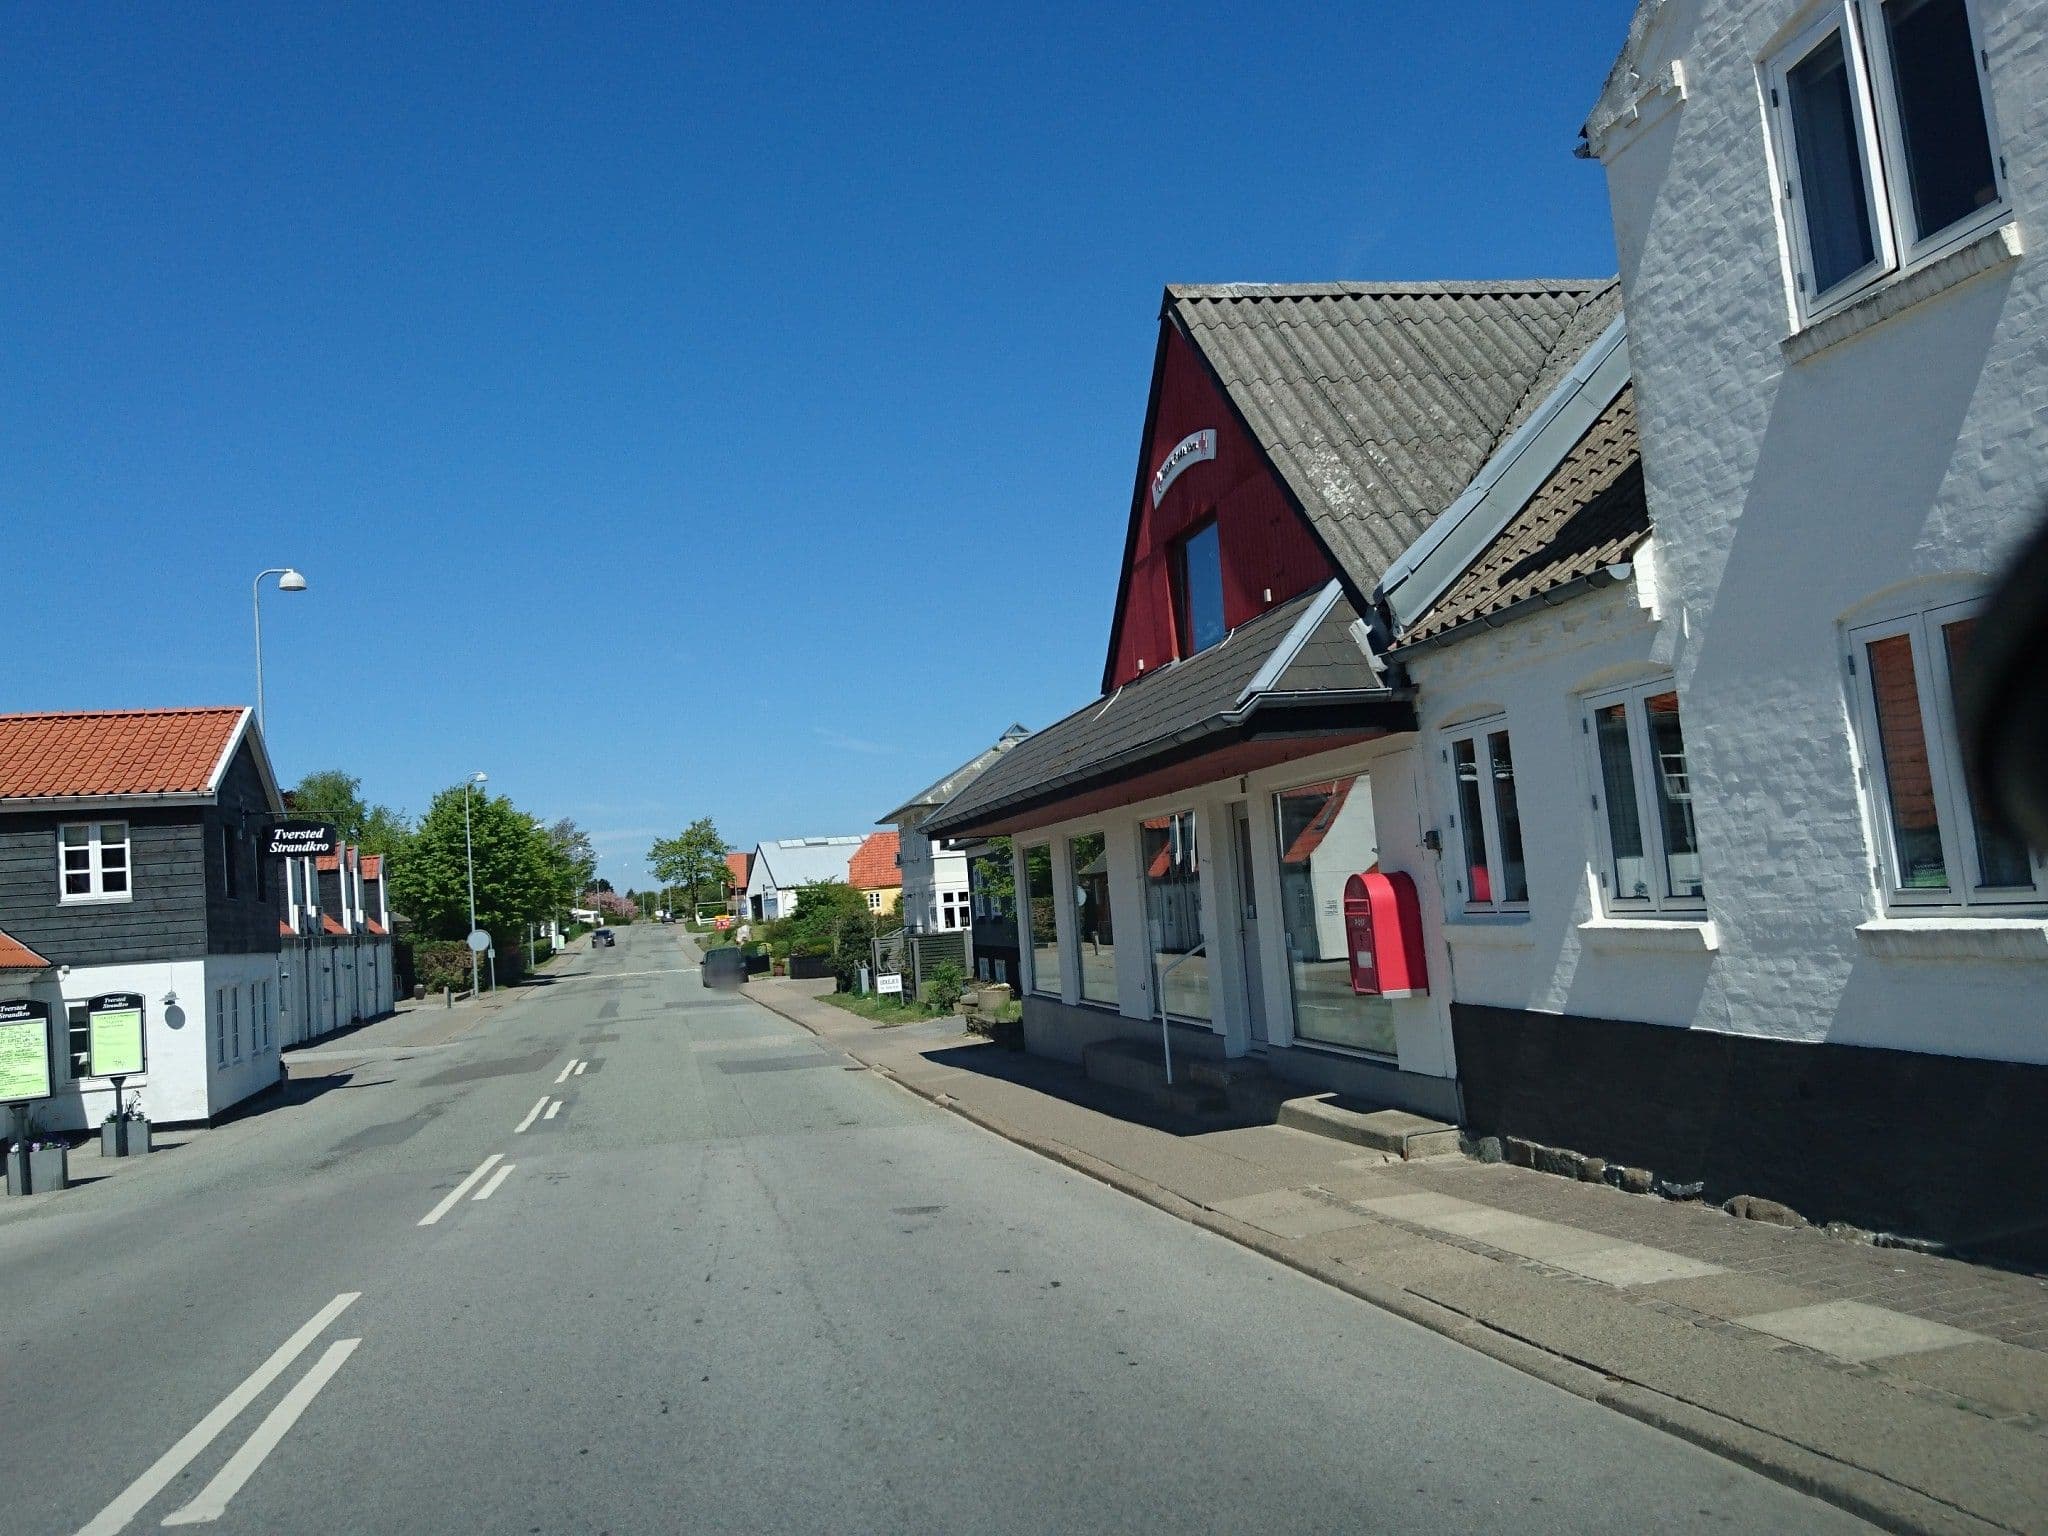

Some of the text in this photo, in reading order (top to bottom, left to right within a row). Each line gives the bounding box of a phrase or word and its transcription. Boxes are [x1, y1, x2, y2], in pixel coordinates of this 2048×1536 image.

[274, 827, 325, 840] Tversted
[269, 841, 330, 853] Strandkro
[0, 1003, 28, 1013] Tversted
